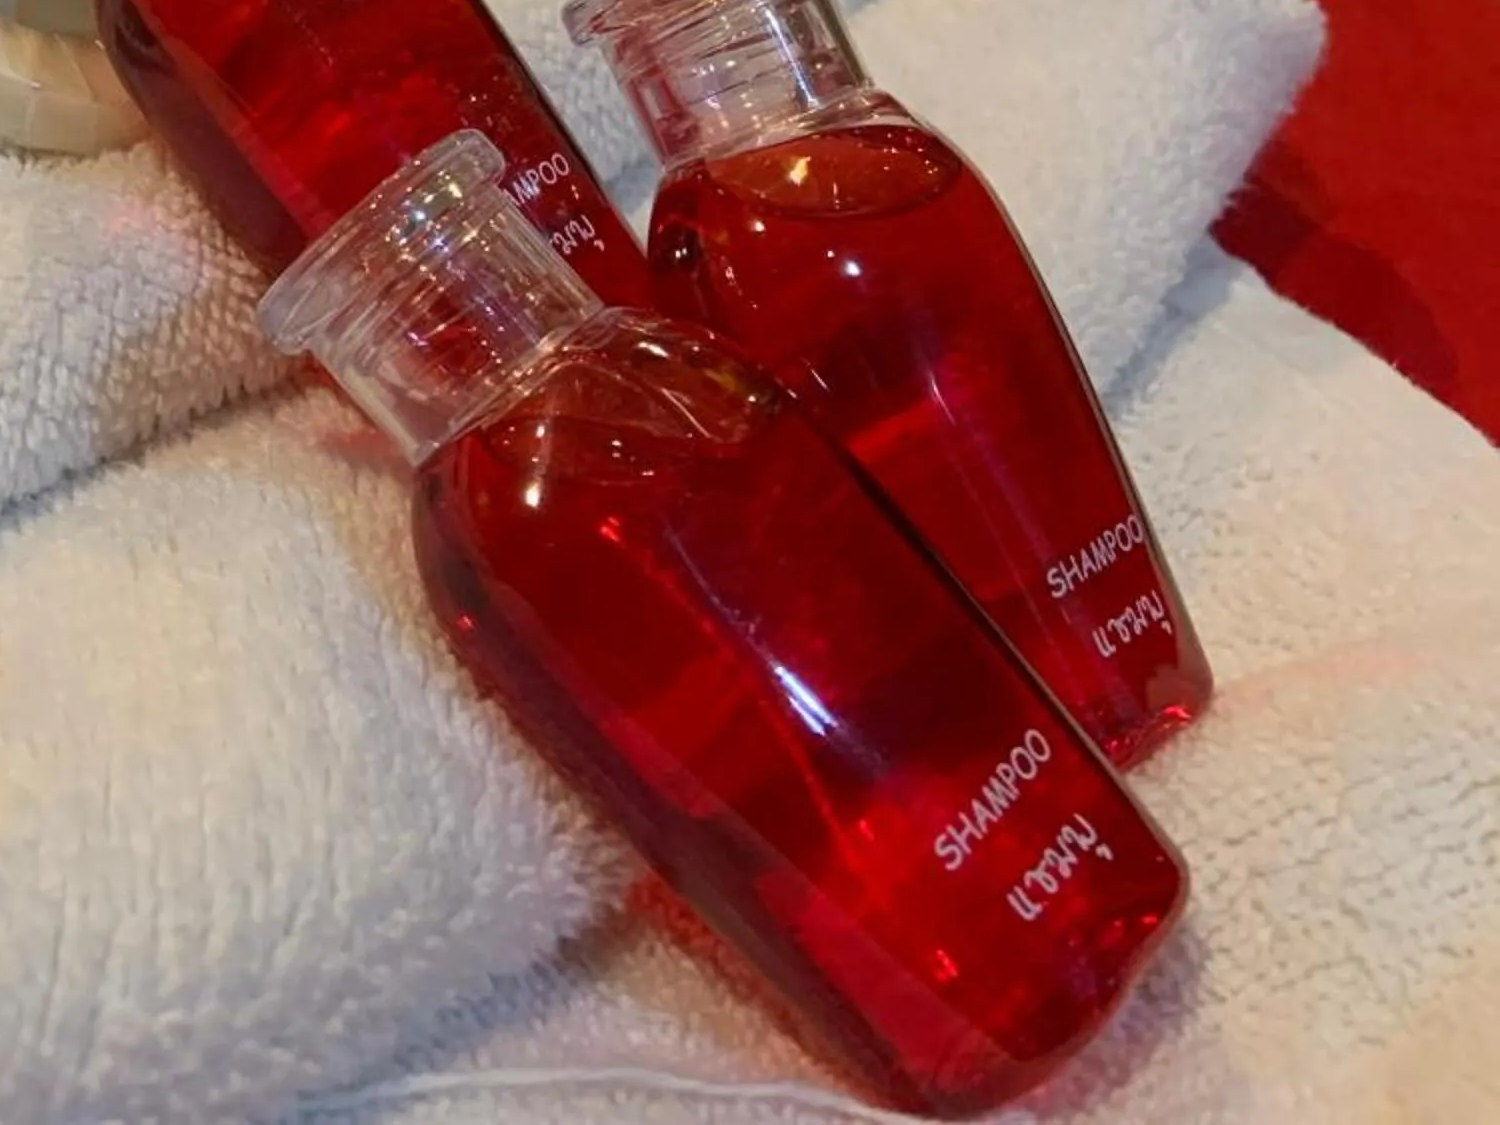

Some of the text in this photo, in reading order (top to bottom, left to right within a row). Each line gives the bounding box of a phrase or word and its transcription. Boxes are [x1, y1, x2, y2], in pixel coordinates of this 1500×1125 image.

[502, 152, 570, 207] MPOO
[548, 214, 605, 255] มพู
[1046, 514, 1144, 599] SHAMPOO
[1091, 589, 1173, 658] แชมพู
[934, 729, 1051, 871] SHAMPOO
[1006, 812, 1114, 921] แชมพู
